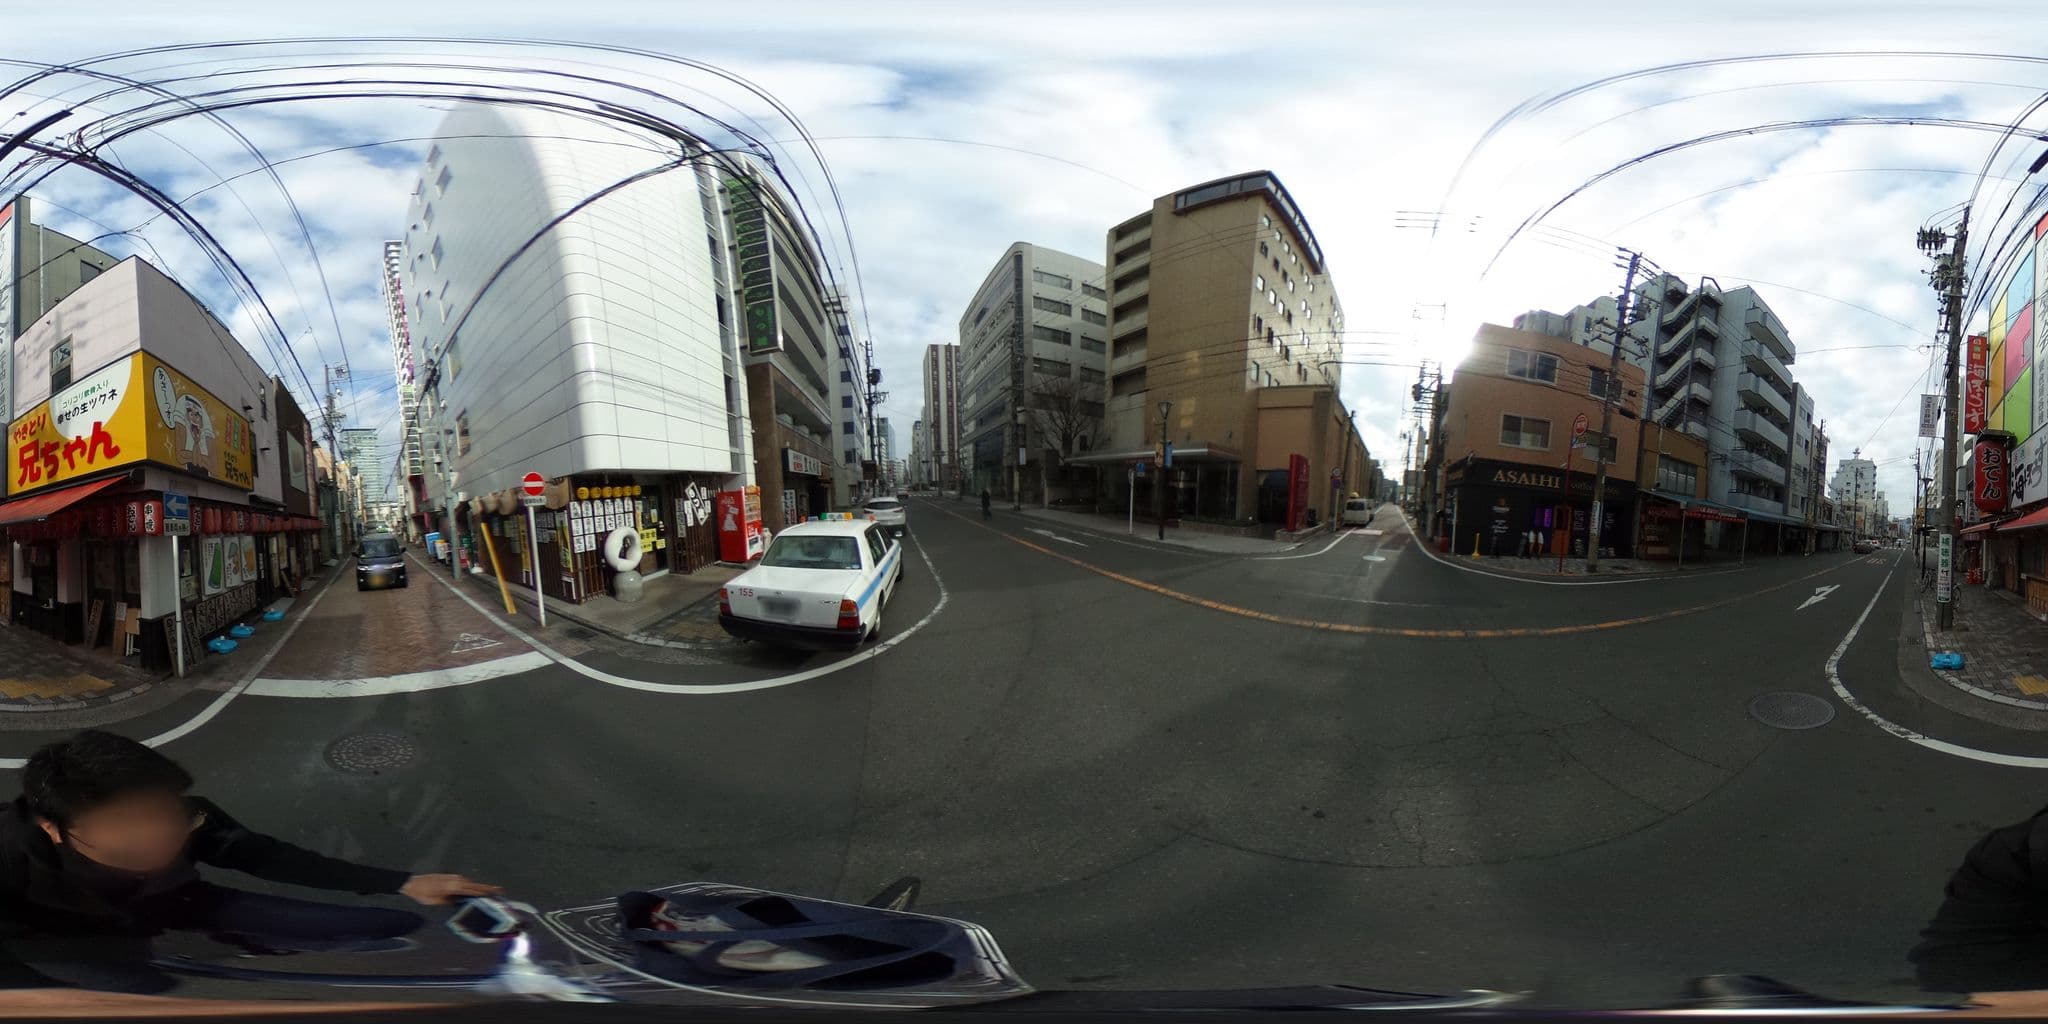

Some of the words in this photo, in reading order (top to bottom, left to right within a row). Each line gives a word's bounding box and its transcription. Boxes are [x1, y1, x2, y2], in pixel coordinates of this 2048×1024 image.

[57, 388, 118, 424] 幸せの生ツクネ
[13, 413, 46, 444] やきとり
[17, 421, 121, 487] 兄ちゃん
[1982, 448, 2001, 499] おでん
[738, 587, 754, 597] 155
